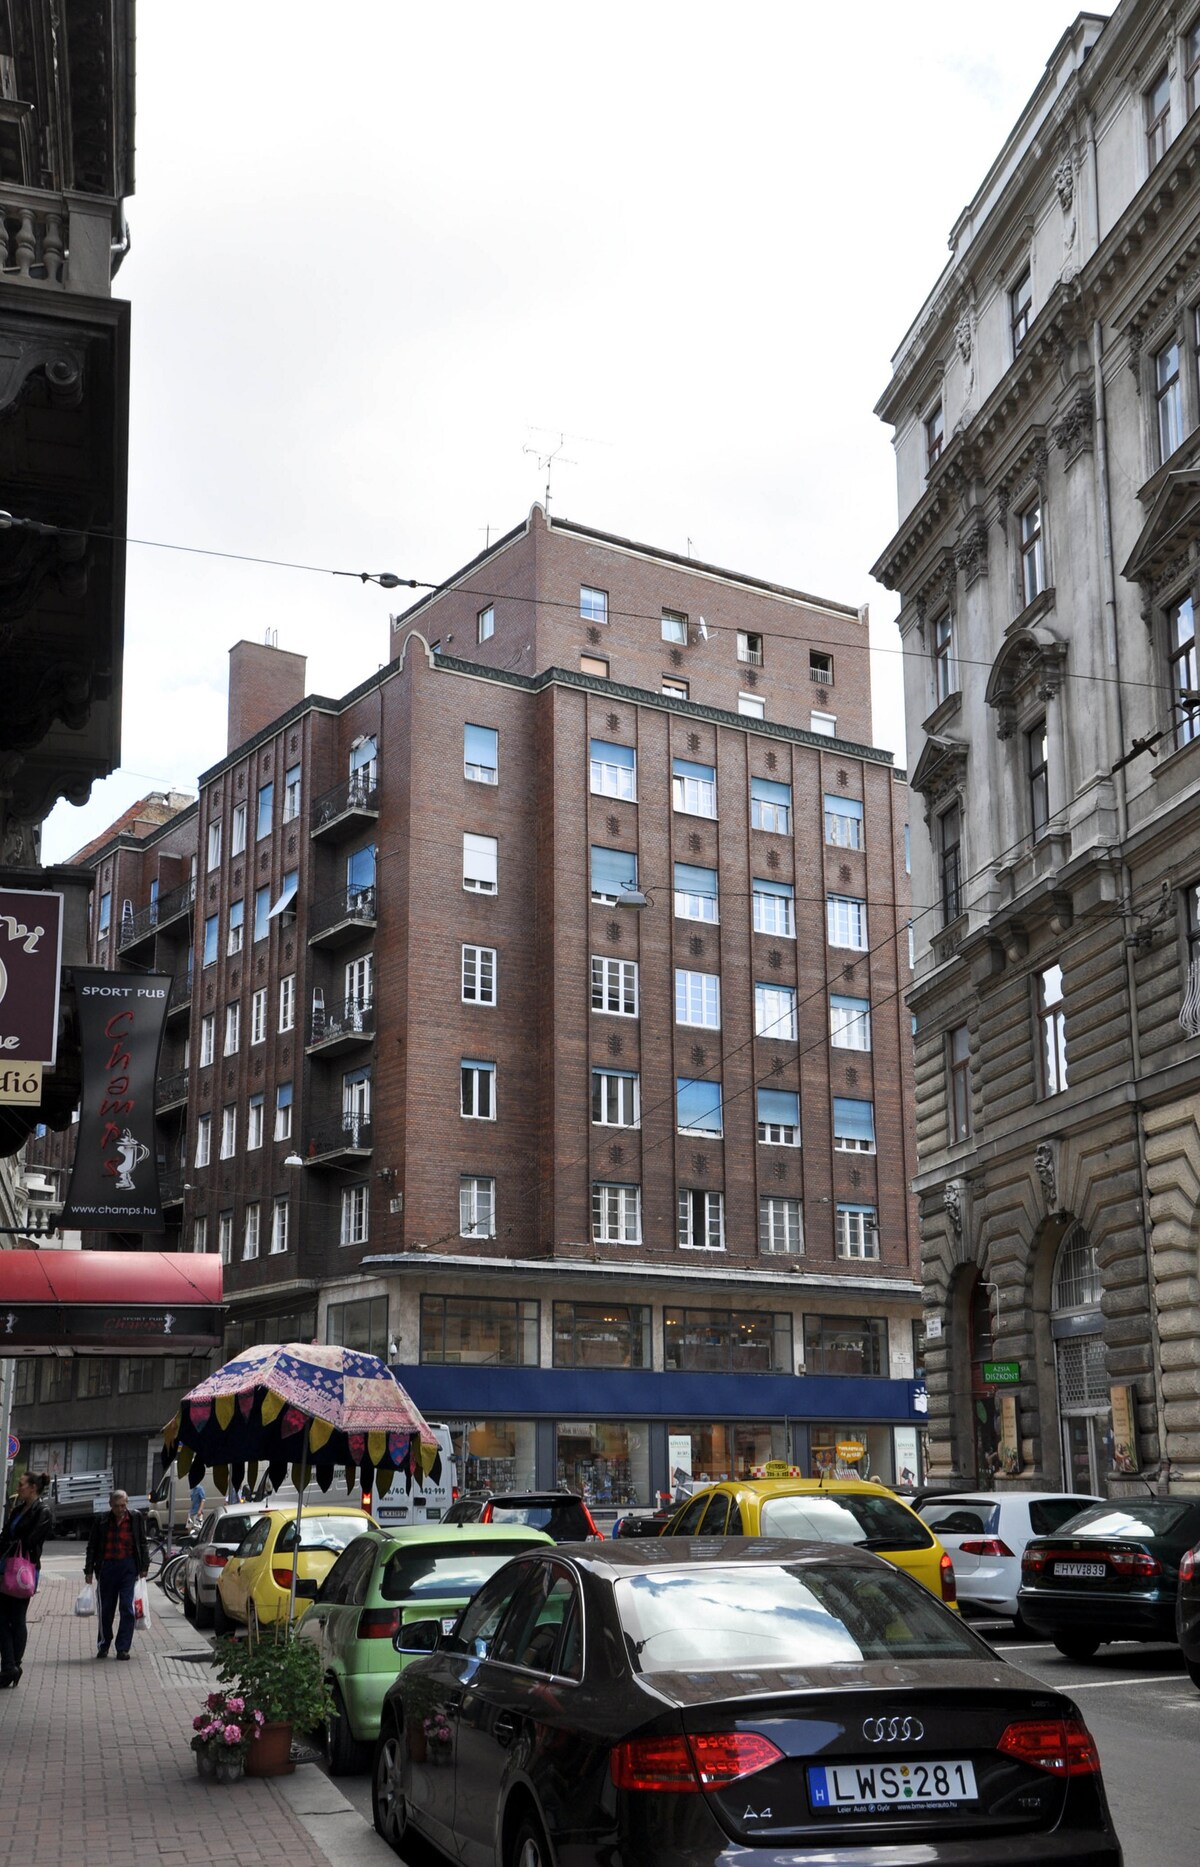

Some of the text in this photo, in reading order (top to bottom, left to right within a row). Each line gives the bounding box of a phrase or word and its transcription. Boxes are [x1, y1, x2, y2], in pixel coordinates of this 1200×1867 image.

[82, 986, 165, 998] SPORT PUB
[71, 1204, 157, 1215] www.champs.hu
[985, 1372, 1018, 1381] DISZKONT
[816, 1789, 825, 1800] H
[742, 1804, 773, 1819] A4
